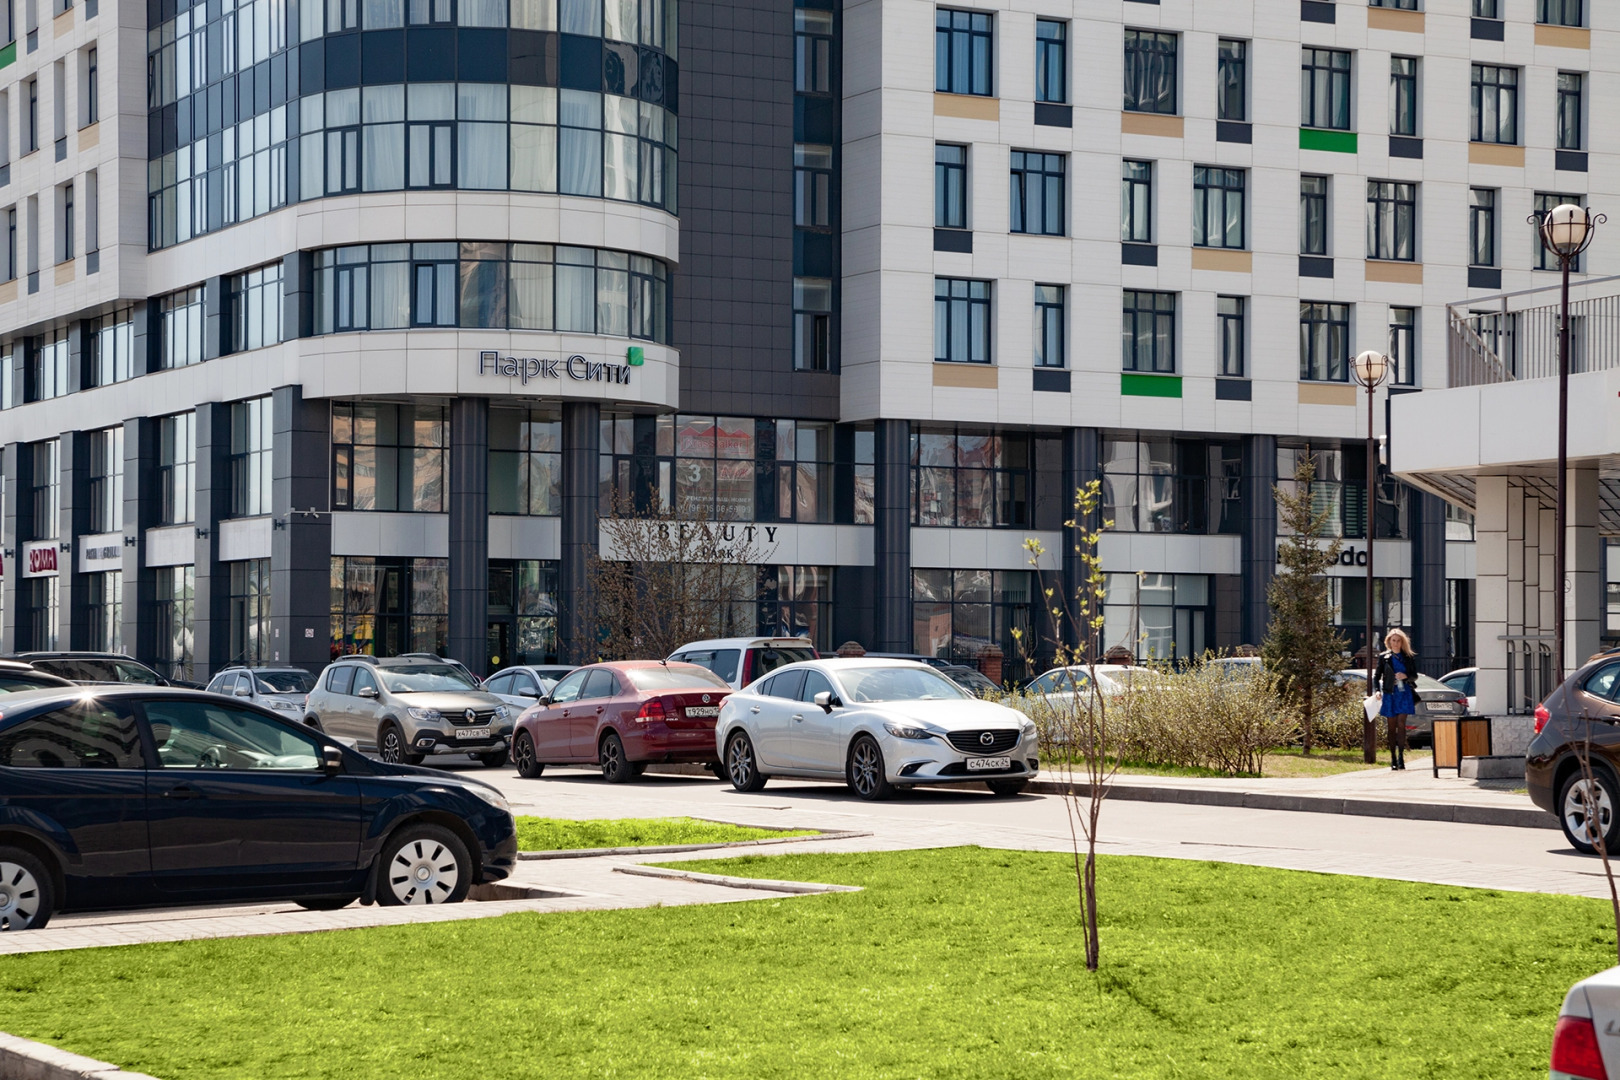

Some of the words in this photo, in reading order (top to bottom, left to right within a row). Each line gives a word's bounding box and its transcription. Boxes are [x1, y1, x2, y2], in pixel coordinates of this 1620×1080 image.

[479, 350, 560, 385] Парк
[567, 354, 631, 384] Сити
[658, 524, 777, 542] BEAUTY
[29, 547, 57, 573] ROMA
